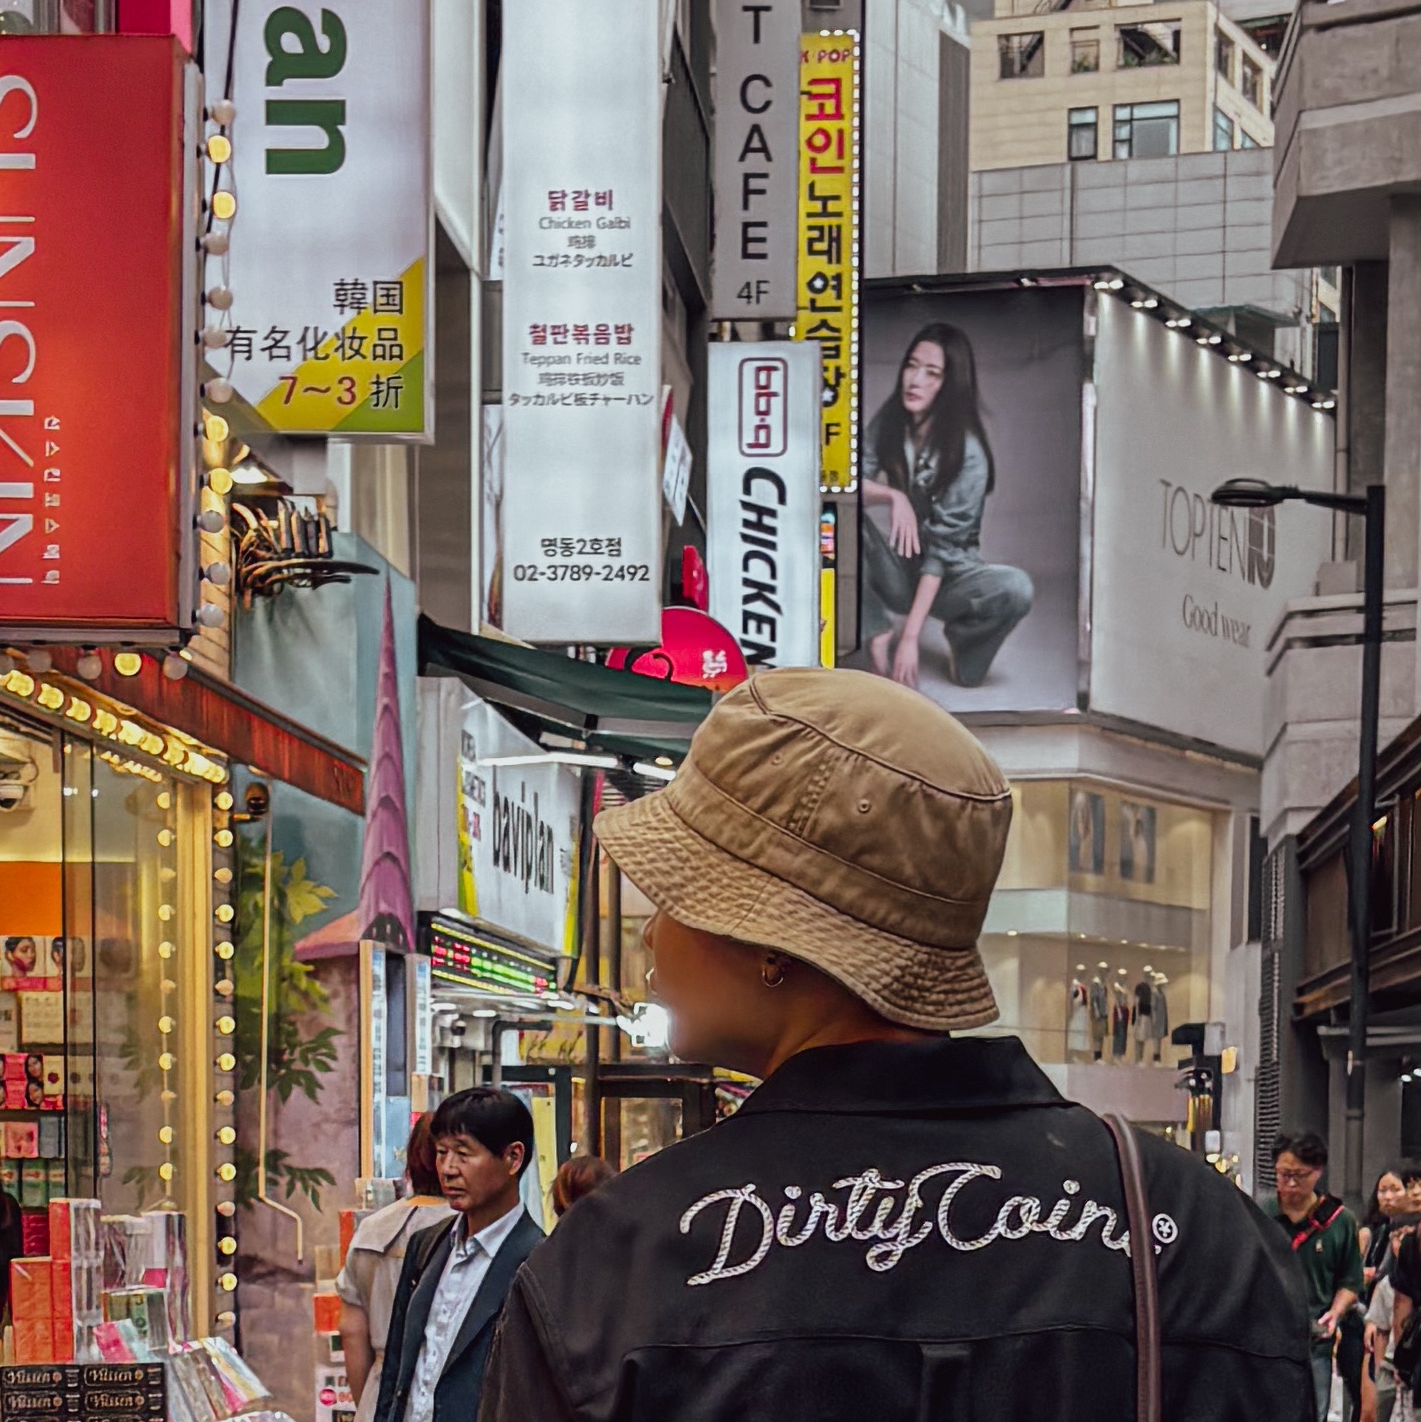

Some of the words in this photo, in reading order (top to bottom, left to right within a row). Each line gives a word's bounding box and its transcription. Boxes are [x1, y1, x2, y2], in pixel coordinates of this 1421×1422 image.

[738, 73, 773, 260] CAFE
[548, 189, 613, 212] 닭갈비
[539, 217, 591, 230] Chicken
[596, 217, 631, 230] Galbi
[332, 278, 404, 315] 韓国
[737, 281, 770, 305] 4F
[224, 325, 404, 362] 有名化妆品
[529, 323, 634, 346] 철판볶음밥
[521, 352, 572, 368] Teppan
[576, 352, 609, 366] Fried
[614, 352, 642, 366] Rice
[541, 537, 622, 558] 명동2호점
[513, 564, 650, 582] 02-3789-2492
[739, 466, 787, 669] CHICKEN
[1182, 593, 1218, 637] Good
[493, 765, 554, 895] baviplan
[680, 1168, 933, 1286] Dirty
[909, 1162, 1161, 1258] Coin
